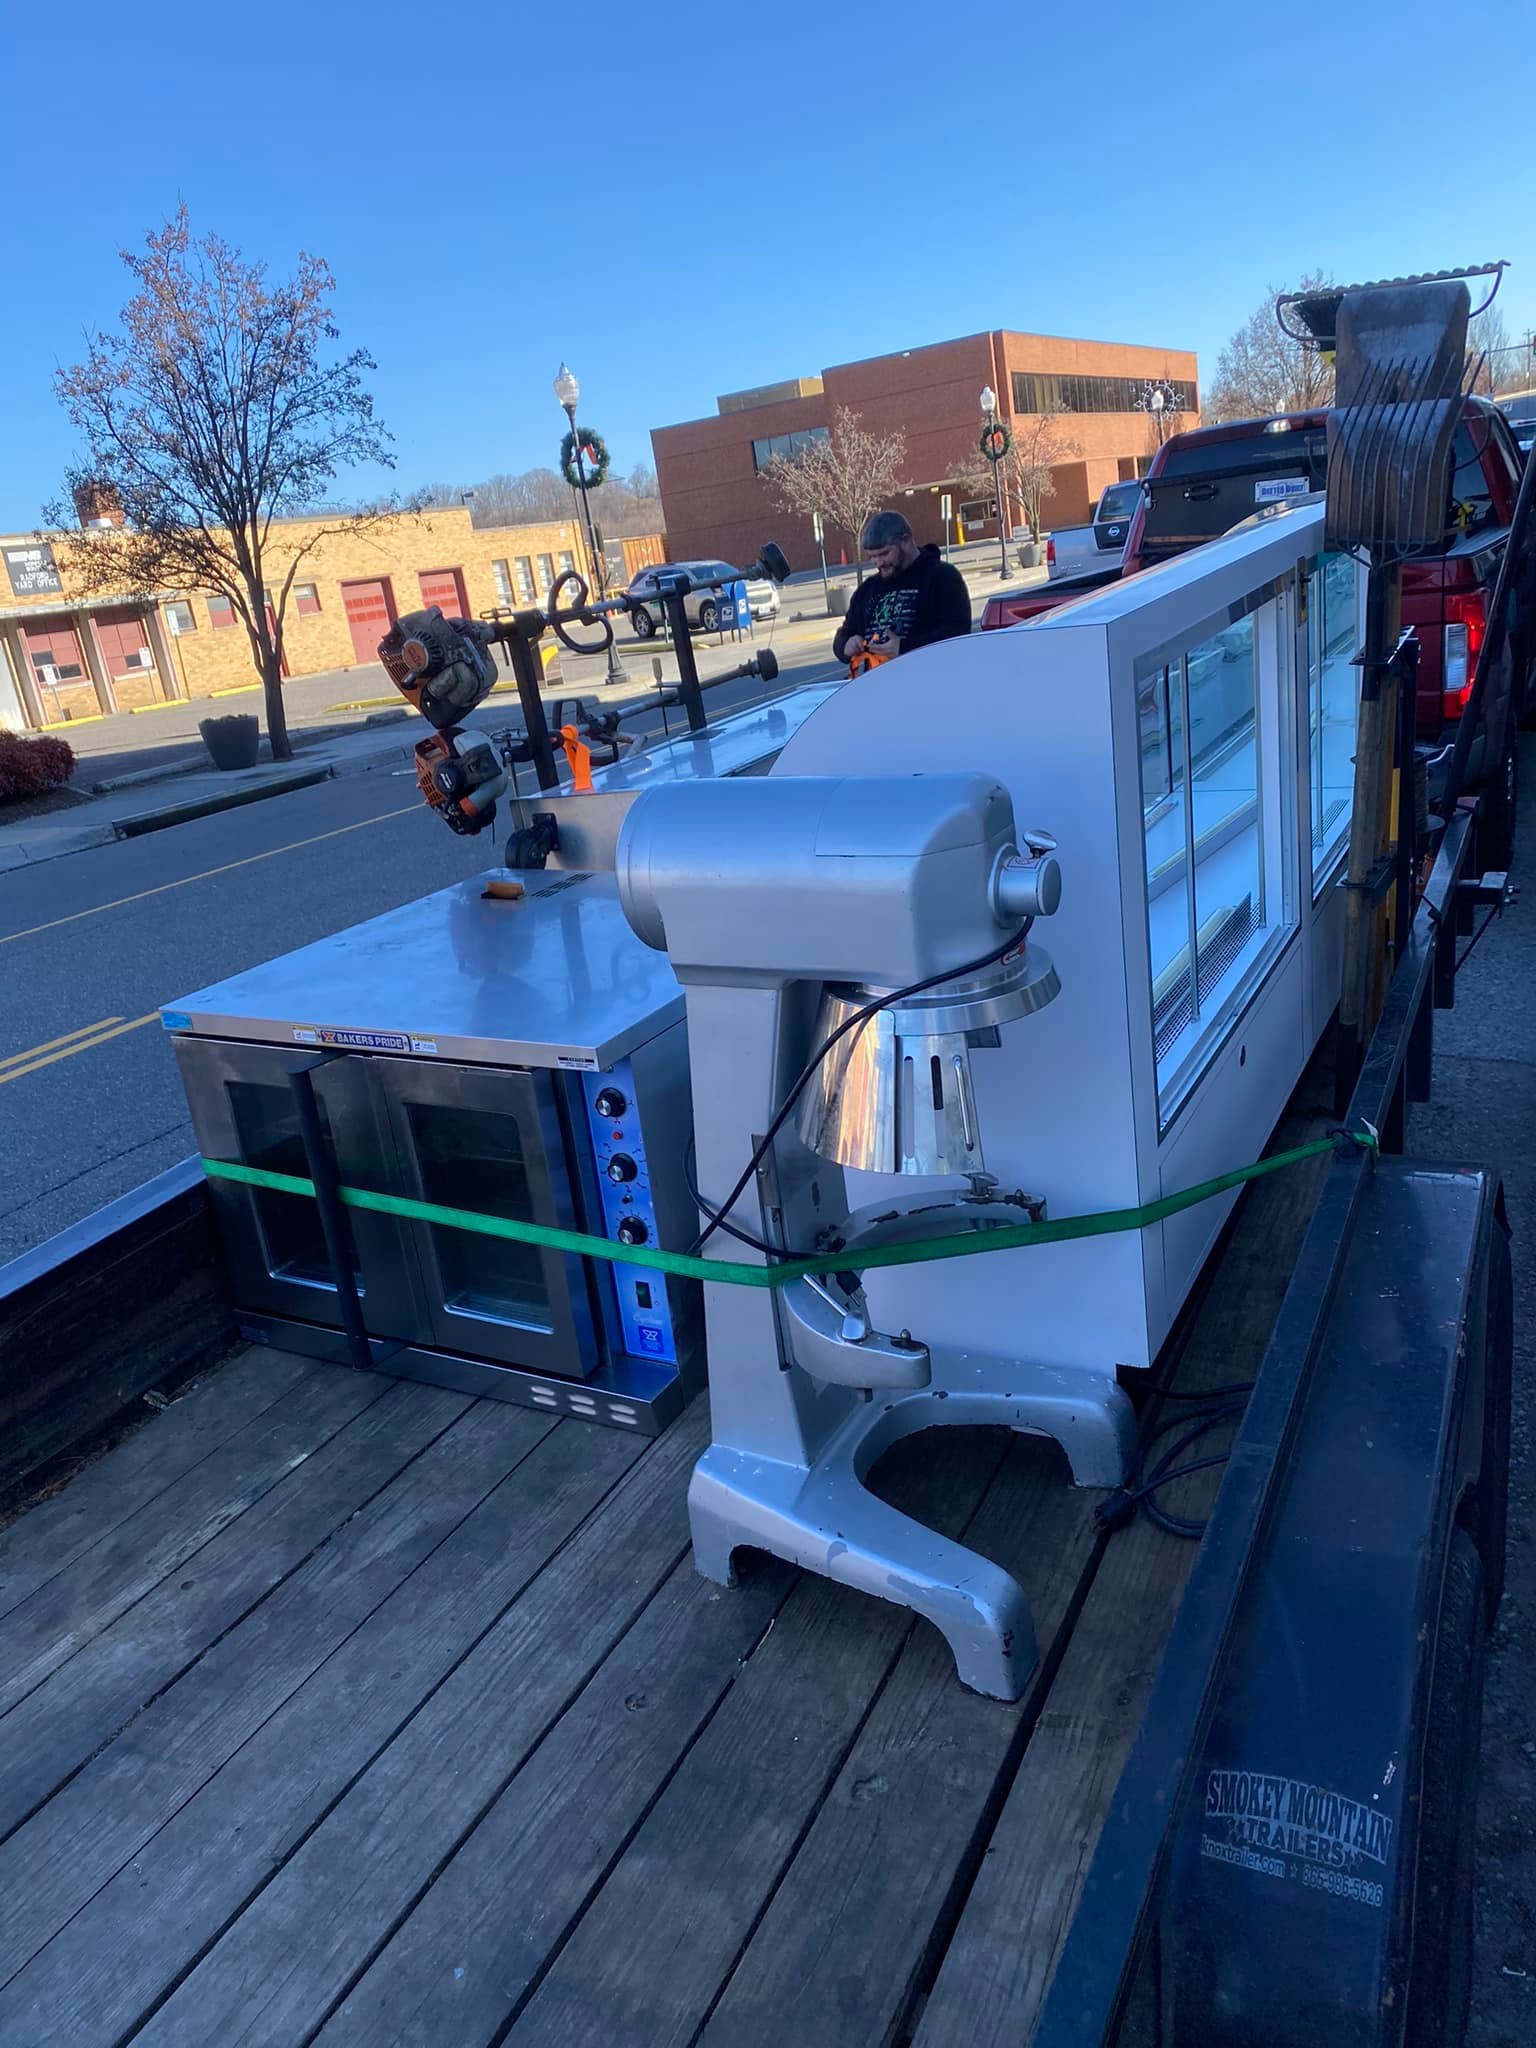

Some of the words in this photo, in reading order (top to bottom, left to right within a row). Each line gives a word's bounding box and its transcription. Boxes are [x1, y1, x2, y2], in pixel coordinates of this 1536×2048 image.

[337, 1034, 374, 1046] BAKERS
[375, 1037, 403, 1049] PRIDE
[1206, 1770, 1288, 1820] SMOKEY
[1287, 1779, 1393, 1865] MOUNTAIN
[1245, 1818, 1346, 1867] TRAILERS
